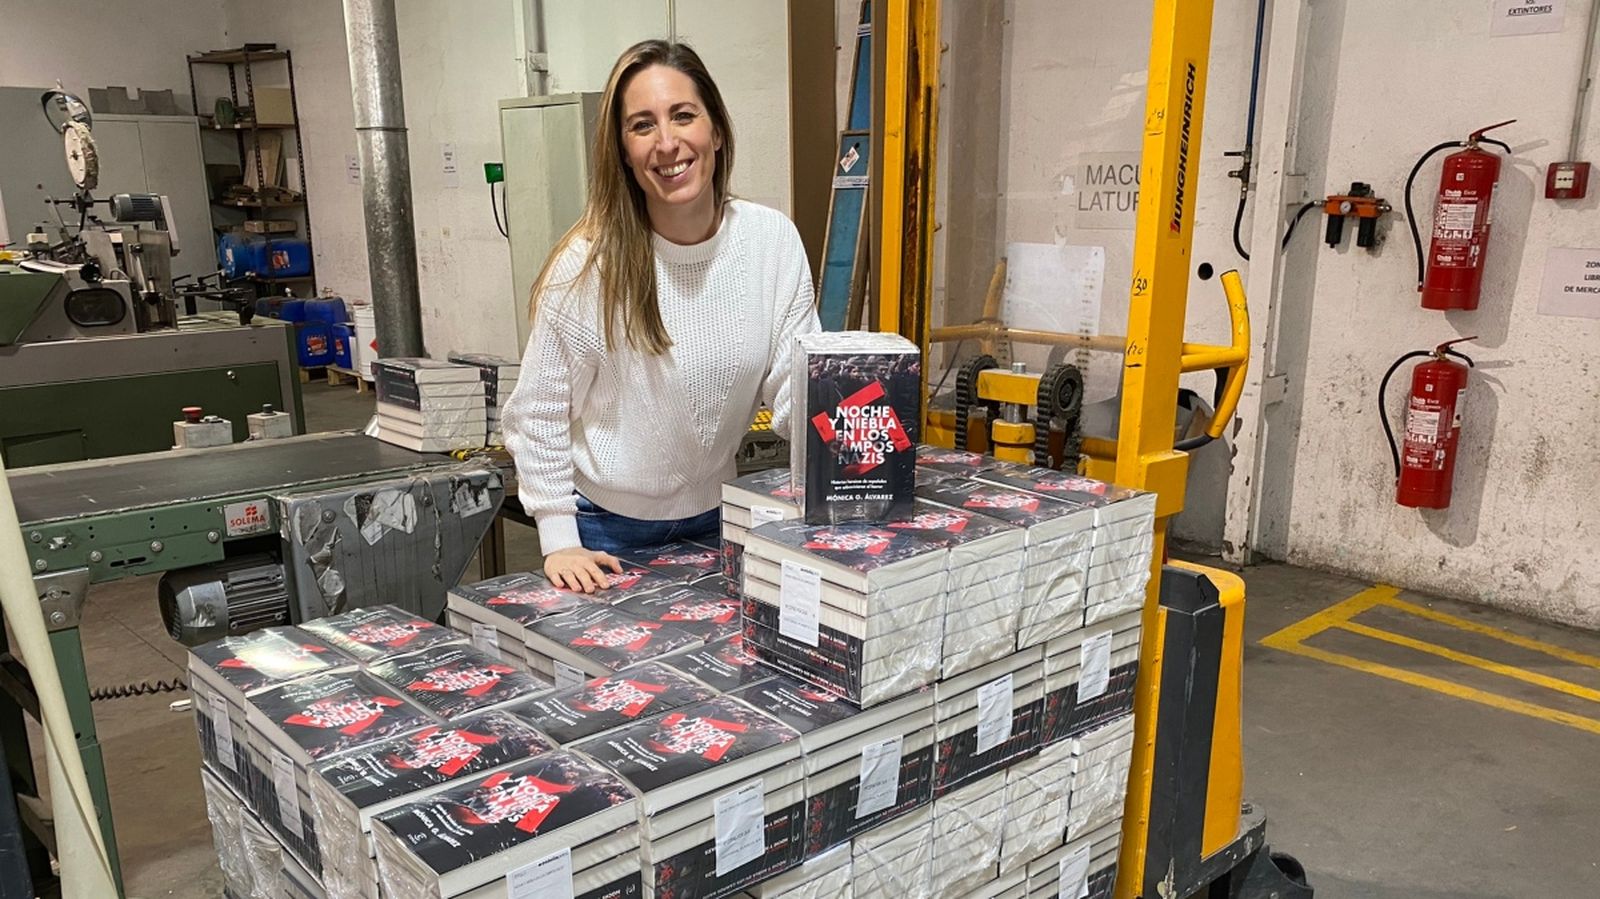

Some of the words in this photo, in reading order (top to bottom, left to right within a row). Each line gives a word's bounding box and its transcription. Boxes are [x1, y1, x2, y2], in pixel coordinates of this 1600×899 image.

[1170, 63, 1196, 233] JUNGHEINRICH
[836, 406, 890, 418] NOCHE
[829, 418, 838, 430] Y
[844, 418, 896, 430] NIEBLA
[836, 430, 855, 441] EN
[861, 429, 889, 441] LOS
[838, 452, 885, 465] NAZIS
[230, 514, 266, 527] SOLEMA
